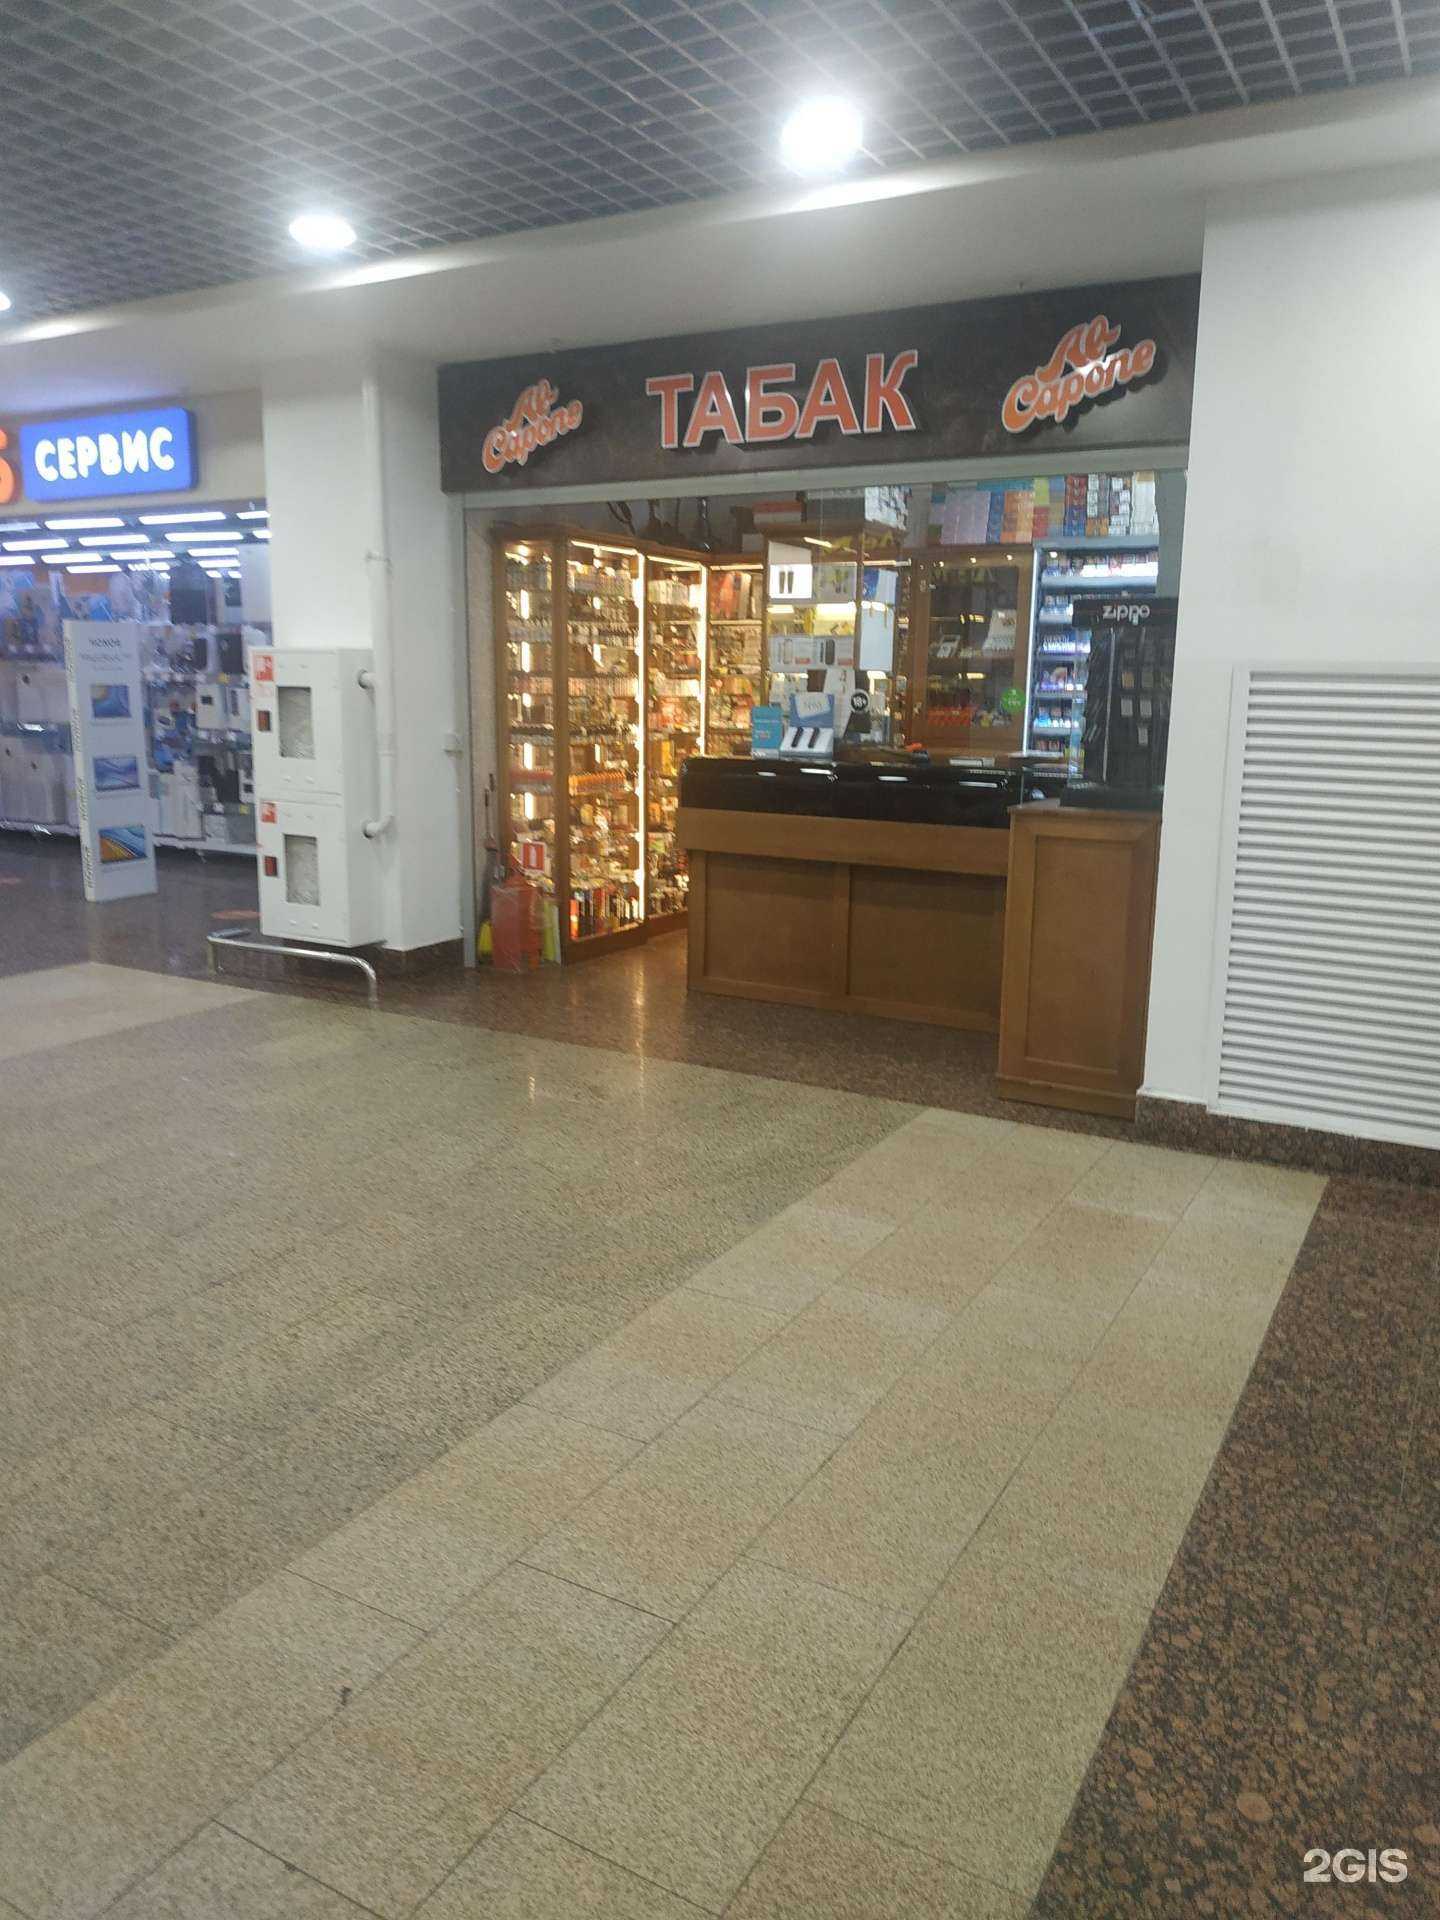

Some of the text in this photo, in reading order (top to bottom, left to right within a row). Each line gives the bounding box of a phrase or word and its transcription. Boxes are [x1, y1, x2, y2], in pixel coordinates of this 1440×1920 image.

[646, 349, 919, 449] ТАБАК
[1002, 339, 1156, 433] Capone
[34, 426, 175, 482] СЕРВИС
[482, 399, 583, 473] Capone
